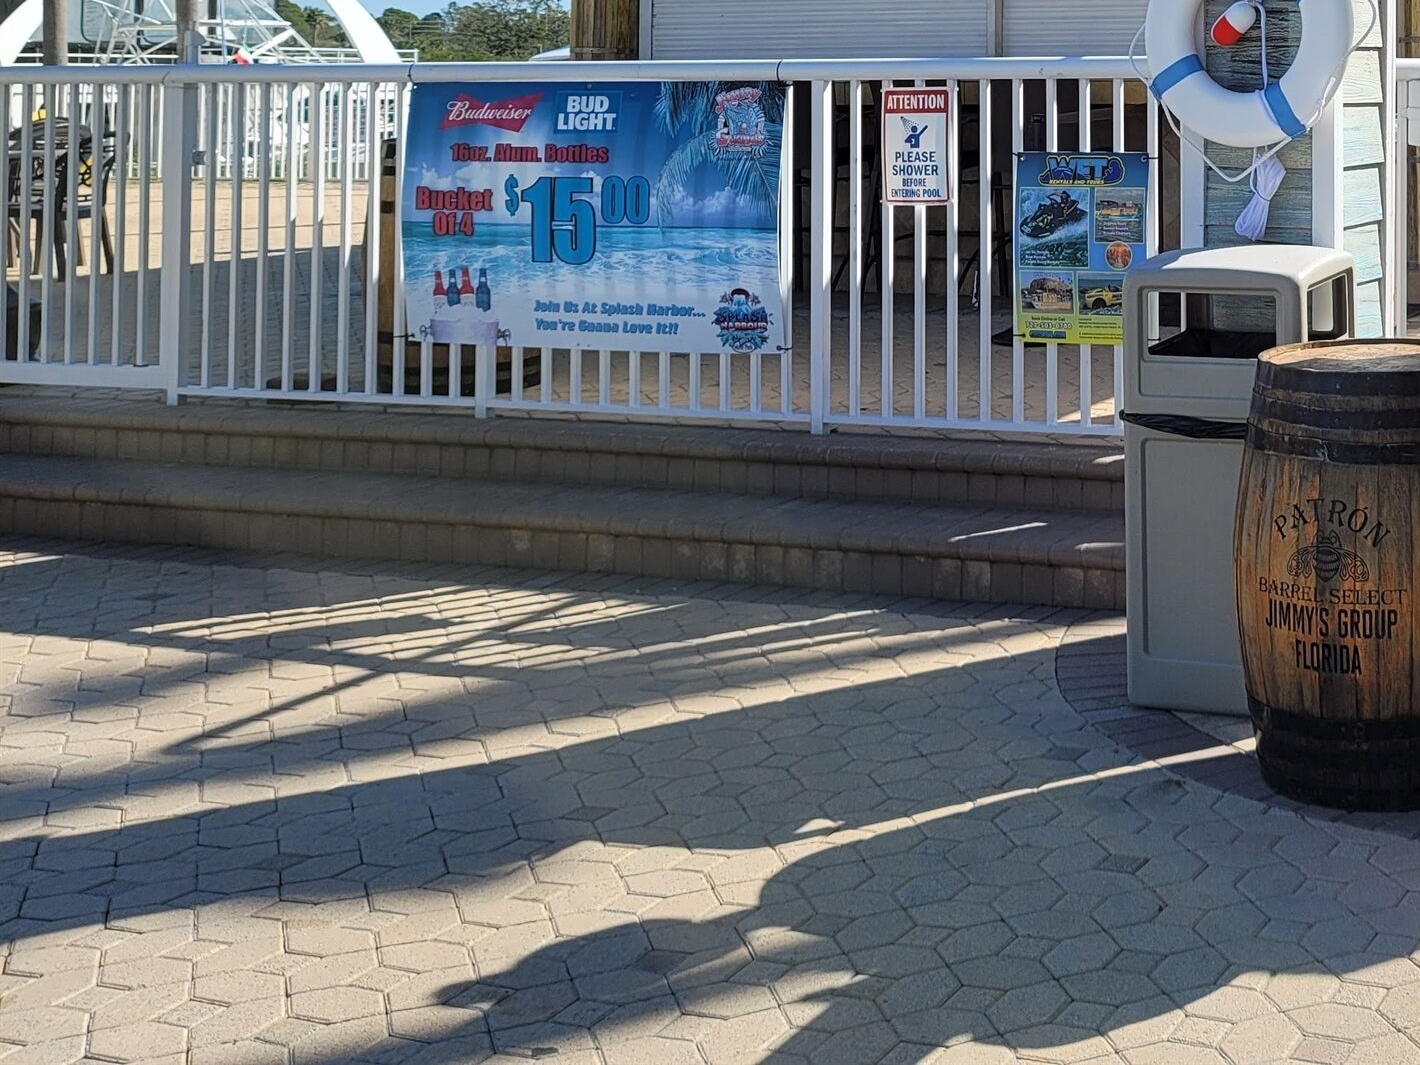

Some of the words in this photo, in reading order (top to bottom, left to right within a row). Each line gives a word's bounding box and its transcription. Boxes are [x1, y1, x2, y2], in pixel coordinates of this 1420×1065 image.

[447, 101, 532, 121] Budweiser
[566, 95, 610, 113] BUD
[887, 94, 945, 110] ATTENTION
[556, 113, 617, 131] LIGHT
[451, 142, 492, 163] 16oz.
[492, 143, 543, 163] Alum.
[544, 143, 610, 164] Bottles
[895, 151, 936, 163] PLEASE
[892, 164, 939, 176] SHOWER
[1048, 158, 1109, 181] WET
[902, 178, 927, 187] BEFORE
[415, 186, 493, 212] Bucket
[891, 188, 921, 198] ENTERING
[922, 188, 942, 198] POOL
[432, 211, 455, 235] Of
[456, 212, 475, 236] 4
[533, 299, 560, 313] Join
[563, 301, 579, 314] Us
[581, 302, 597, 314] At
[600, 302, 644, 316] Splash
[535, 318, 576, 332] You're
[622, 321, 653, 334] Love
[655, 322, 679, 335] It!!
[1273, 498, 1391, 548] PATRÓN
[1259, 576, 1324, 604] BARREL
[1329, 588, 1407, 606] SELECT
[1266, 598, 1329, 638] JIMMY'S
[1338, 608, 1398, 640] GROUP
[1295, 638, 1363, 676] FLORIDA
